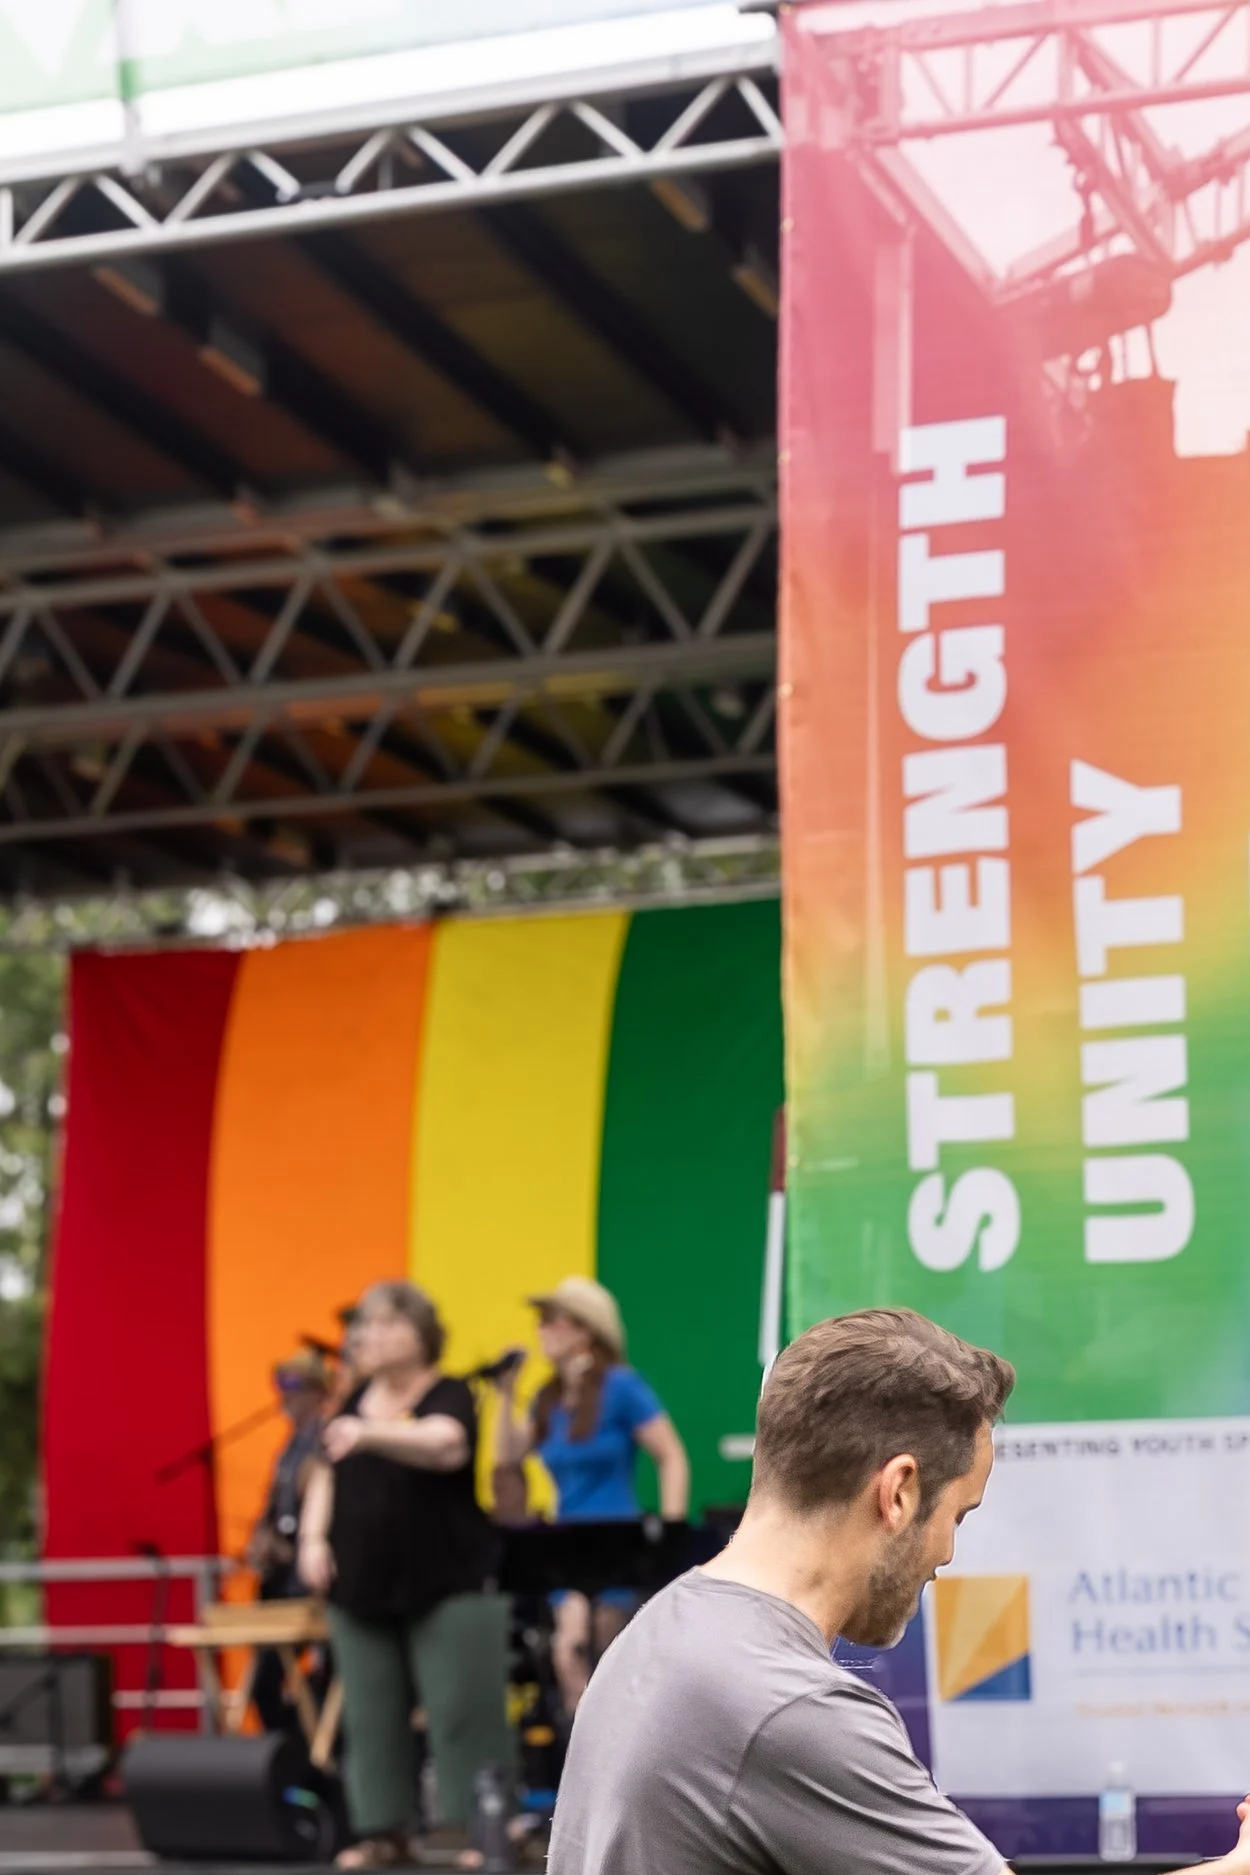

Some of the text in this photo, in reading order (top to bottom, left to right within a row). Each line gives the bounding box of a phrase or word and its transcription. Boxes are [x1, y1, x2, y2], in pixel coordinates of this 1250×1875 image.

[897, 415, 1021, 1273] STRENGTH
[1070, 758, 1196, 1264] UNITY
[995, 1434, 1120, 1461] ESENTING
[1131, 1431, 1213, 1456] YOUTH
[1068, 1568, 1241, 1605] Atlantic
[1070, 1612, 1218, 1654] Health
